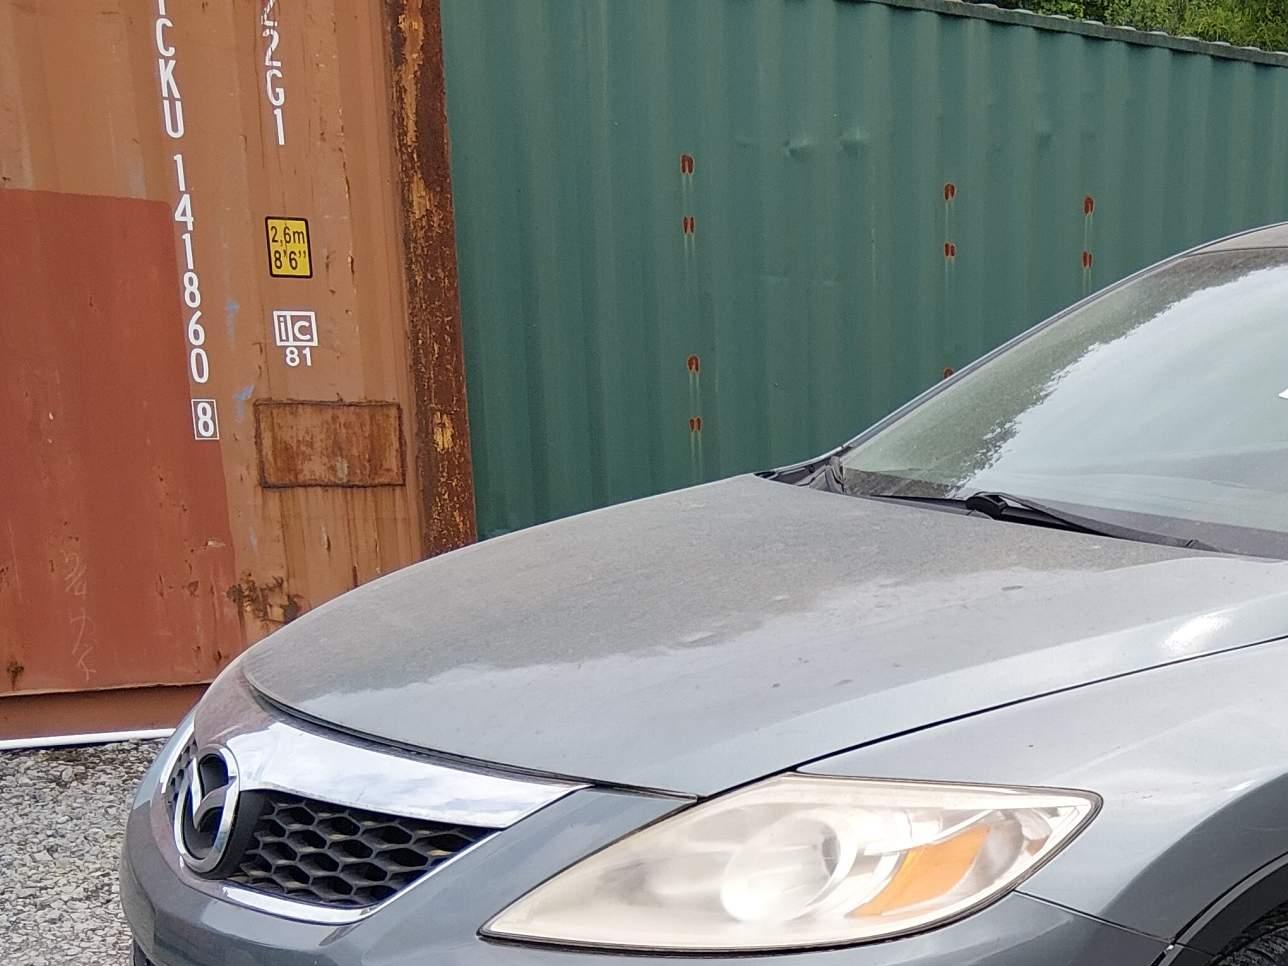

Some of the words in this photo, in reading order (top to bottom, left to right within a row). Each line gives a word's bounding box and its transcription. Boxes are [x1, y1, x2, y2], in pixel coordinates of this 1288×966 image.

[260, 0, 286, 146] 22G1
[270, 225, 306, 247] 2,6m
[173, 153, 210, 384] 141860
[196, 402, 215, 437] 8
[285, 346, 312, 367] 81
